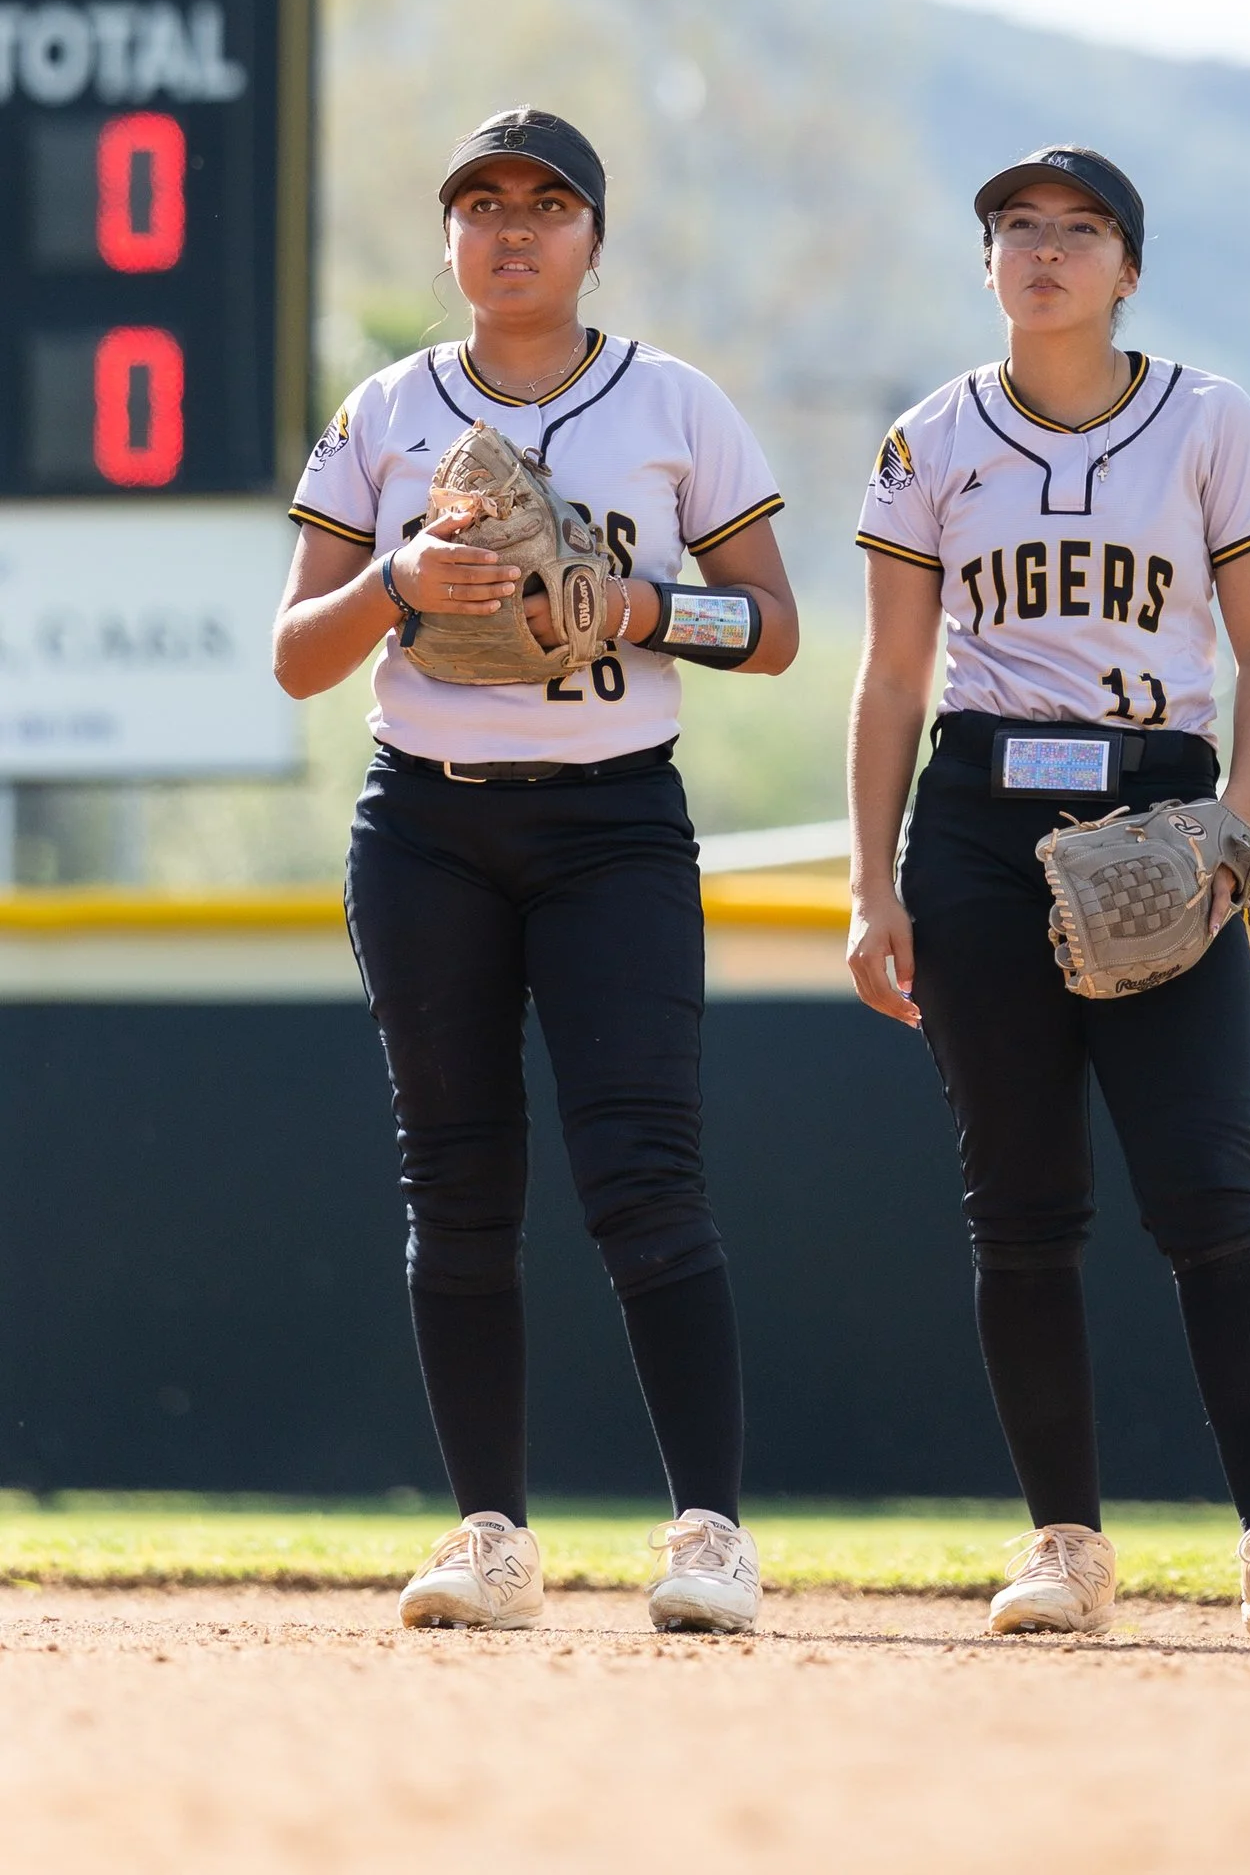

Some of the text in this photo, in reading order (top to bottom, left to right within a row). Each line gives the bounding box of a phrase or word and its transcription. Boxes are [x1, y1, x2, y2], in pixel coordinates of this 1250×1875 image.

[97, 112, 186, 274] 0
[94, 326, 184, 487] 0
[578, 580, 592, 629] Wilson
[960, 539, 1175, 637] TIGERS
[1101, 666, 1168, 727] 11
[1115, 963, 1182, 994] Rawlings
